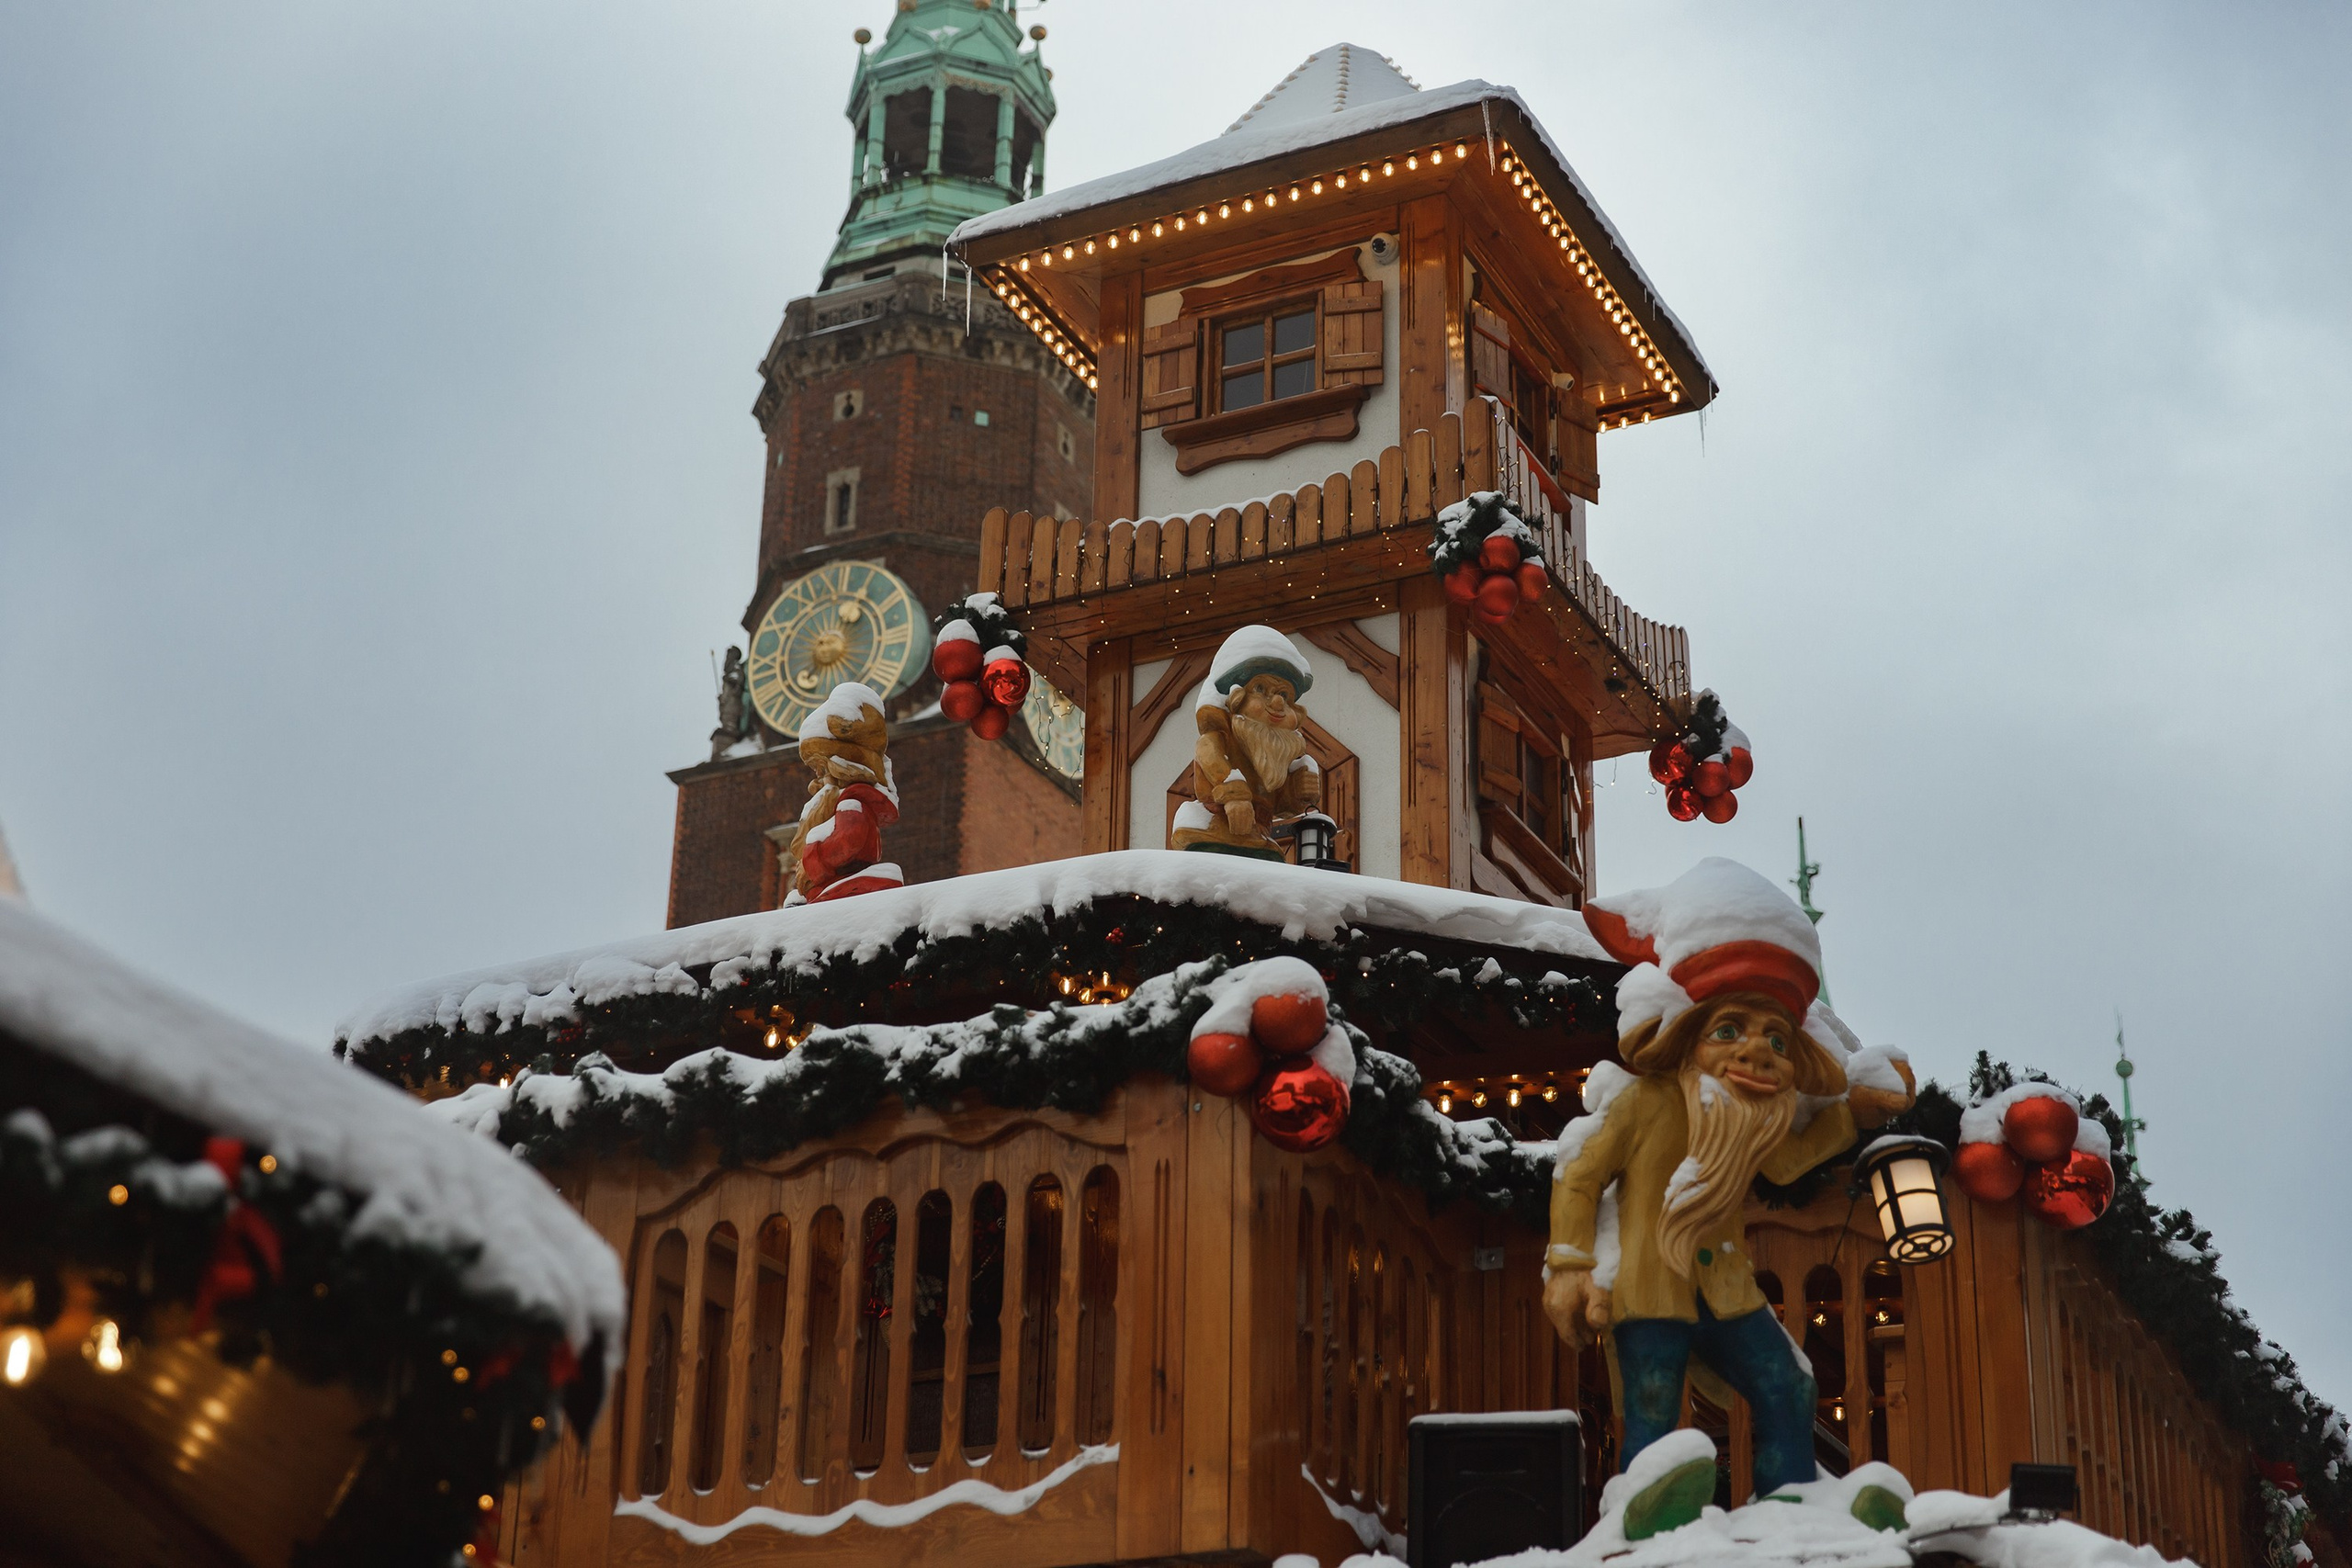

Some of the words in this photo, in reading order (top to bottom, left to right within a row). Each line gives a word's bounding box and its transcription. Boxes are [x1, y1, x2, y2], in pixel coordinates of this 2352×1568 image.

[788, 579, 818, 613] XI
[878, 589, 904, 614] II
[763, 615, 793, 639] X
[885, 622, 910, 646] III
[752, 651, 778, 682] IX
